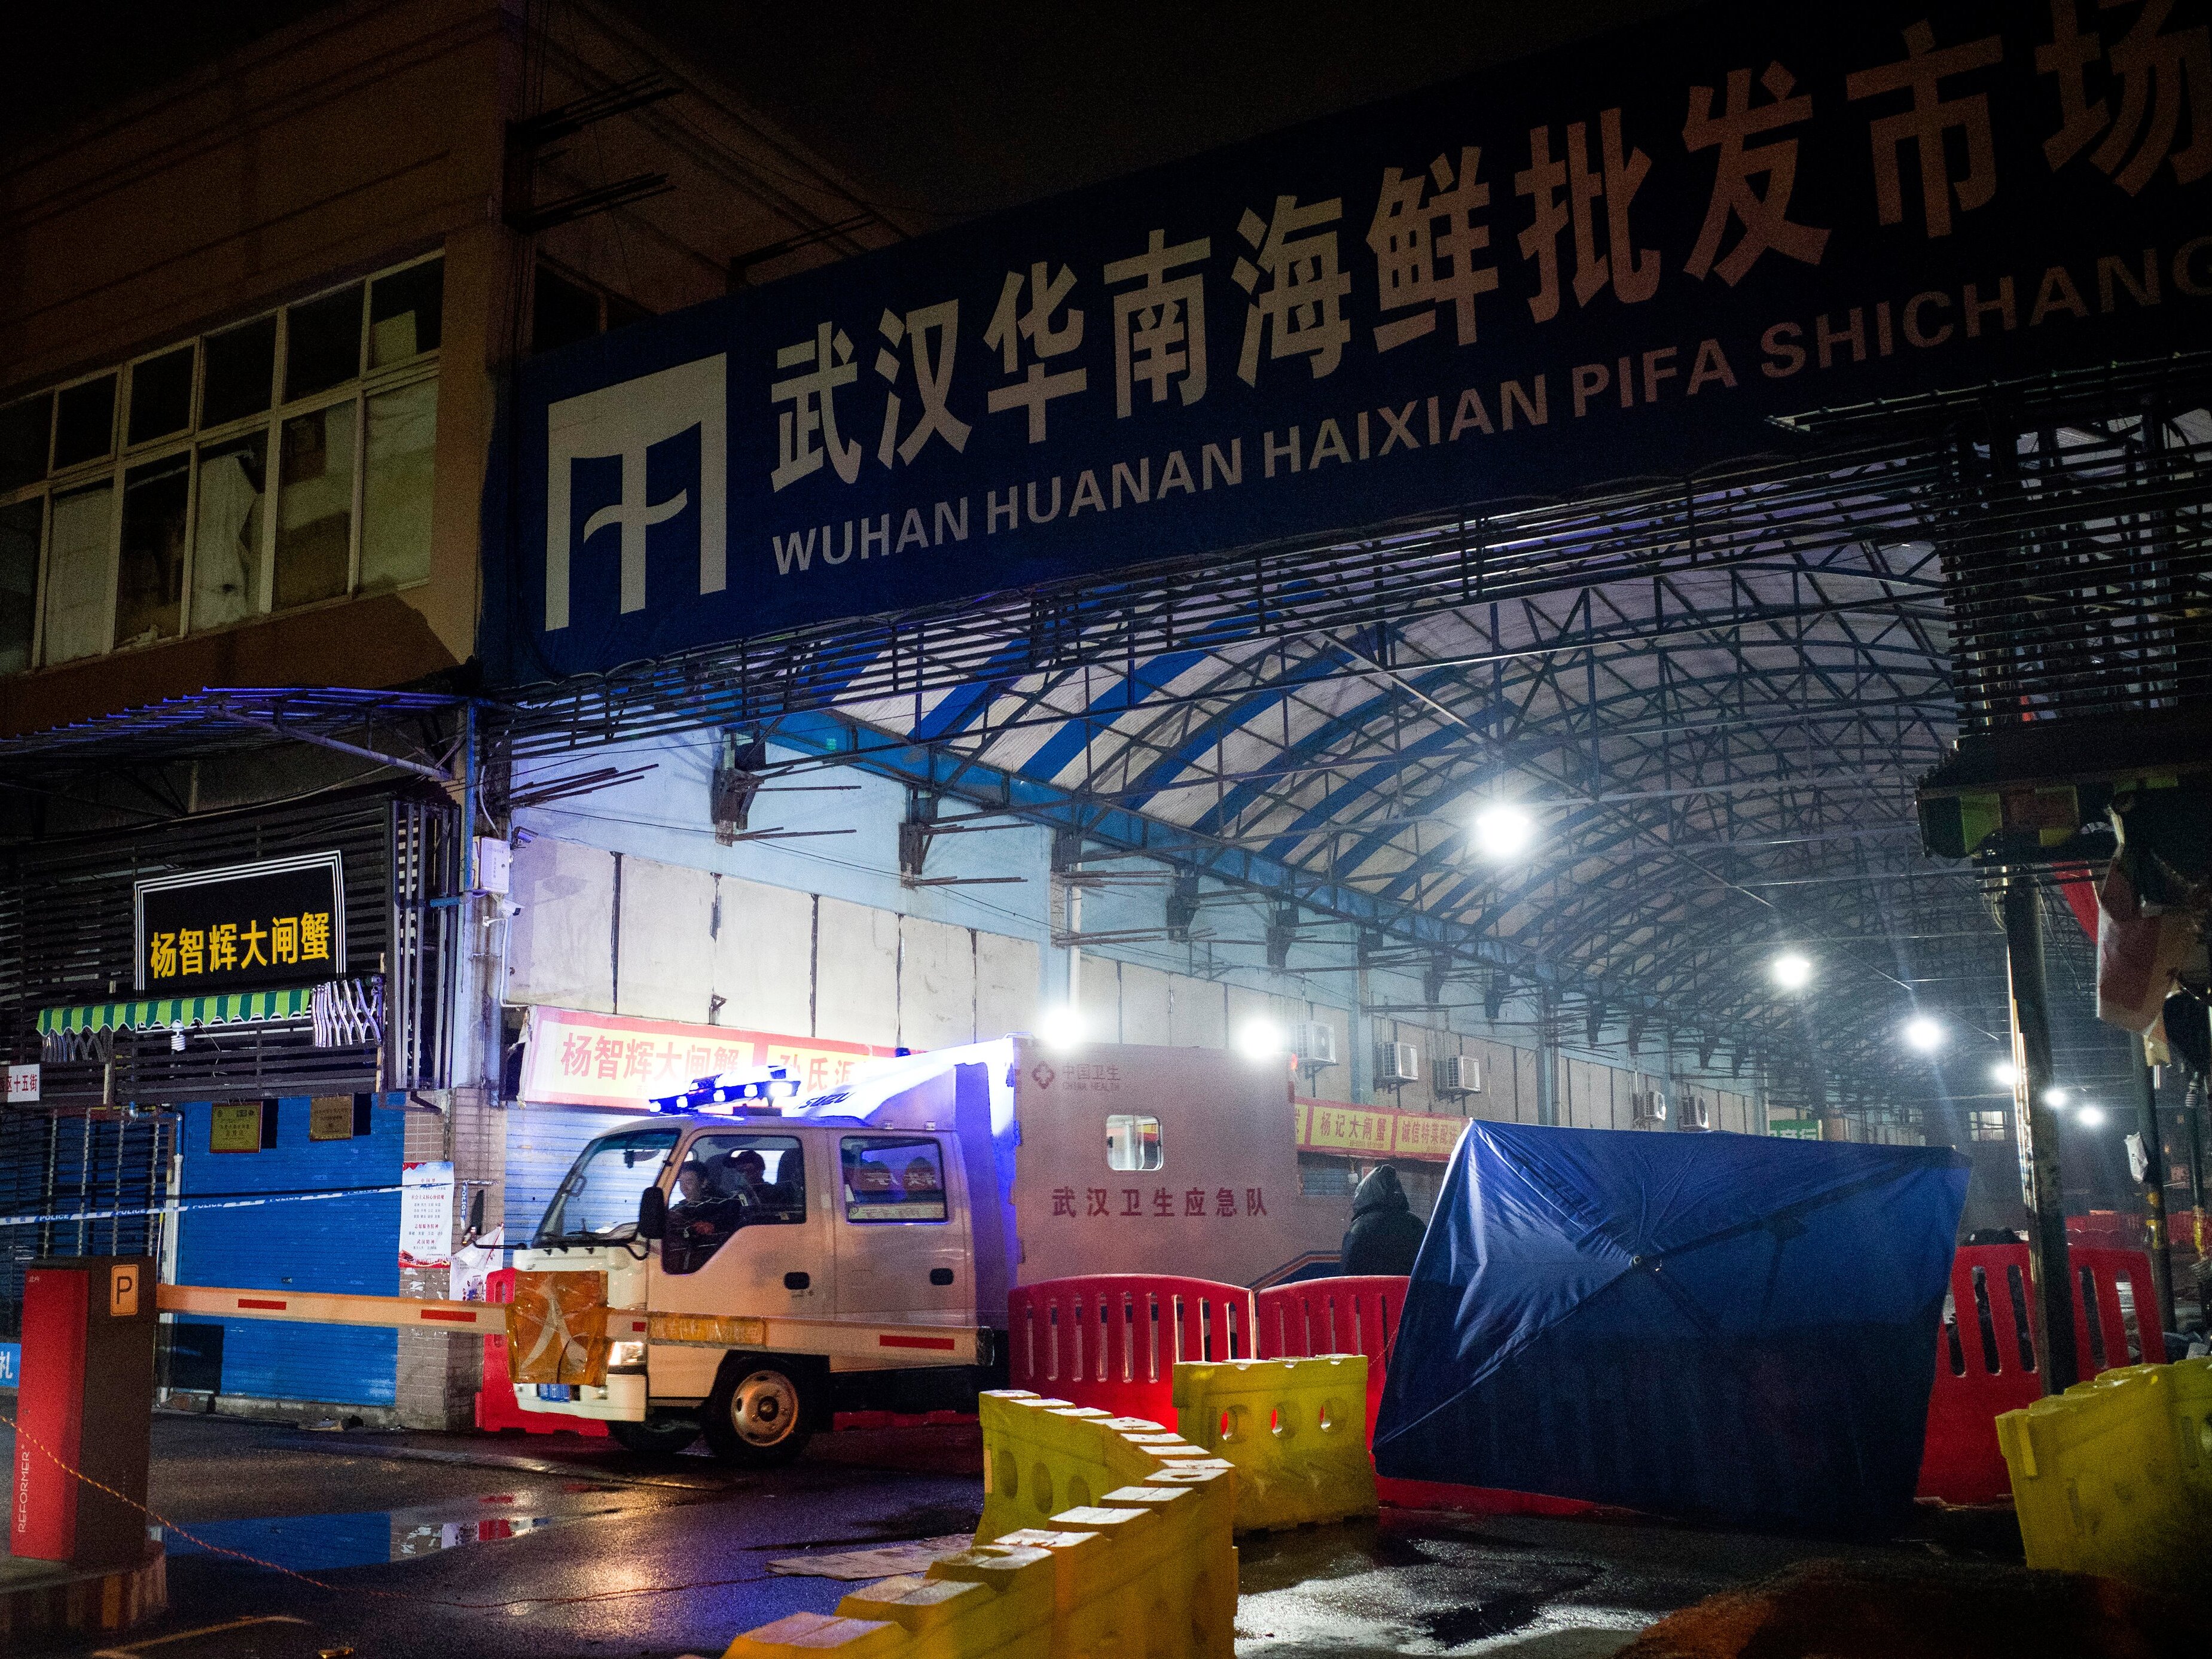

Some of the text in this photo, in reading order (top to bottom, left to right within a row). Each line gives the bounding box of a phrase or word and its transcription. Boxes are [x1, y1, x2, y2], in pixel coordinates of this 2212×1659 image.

[771, 0, 2212, 492] 武汉华南海鲜批发市场
[772, 235, 2212, 577] WUHAN HUANAN HAIXIAN PIFA SHICHANG
[150, 912, 330, 979] 杨智辉大闸蟹
[1062, 1062, 1121, 1081] 中国卫生
[1051, 1186, 1268, 1218] 武汉卫生应急队
[116, 1275, 133, 1305] P
[18, 1451, 30, 1533] REFORMER
